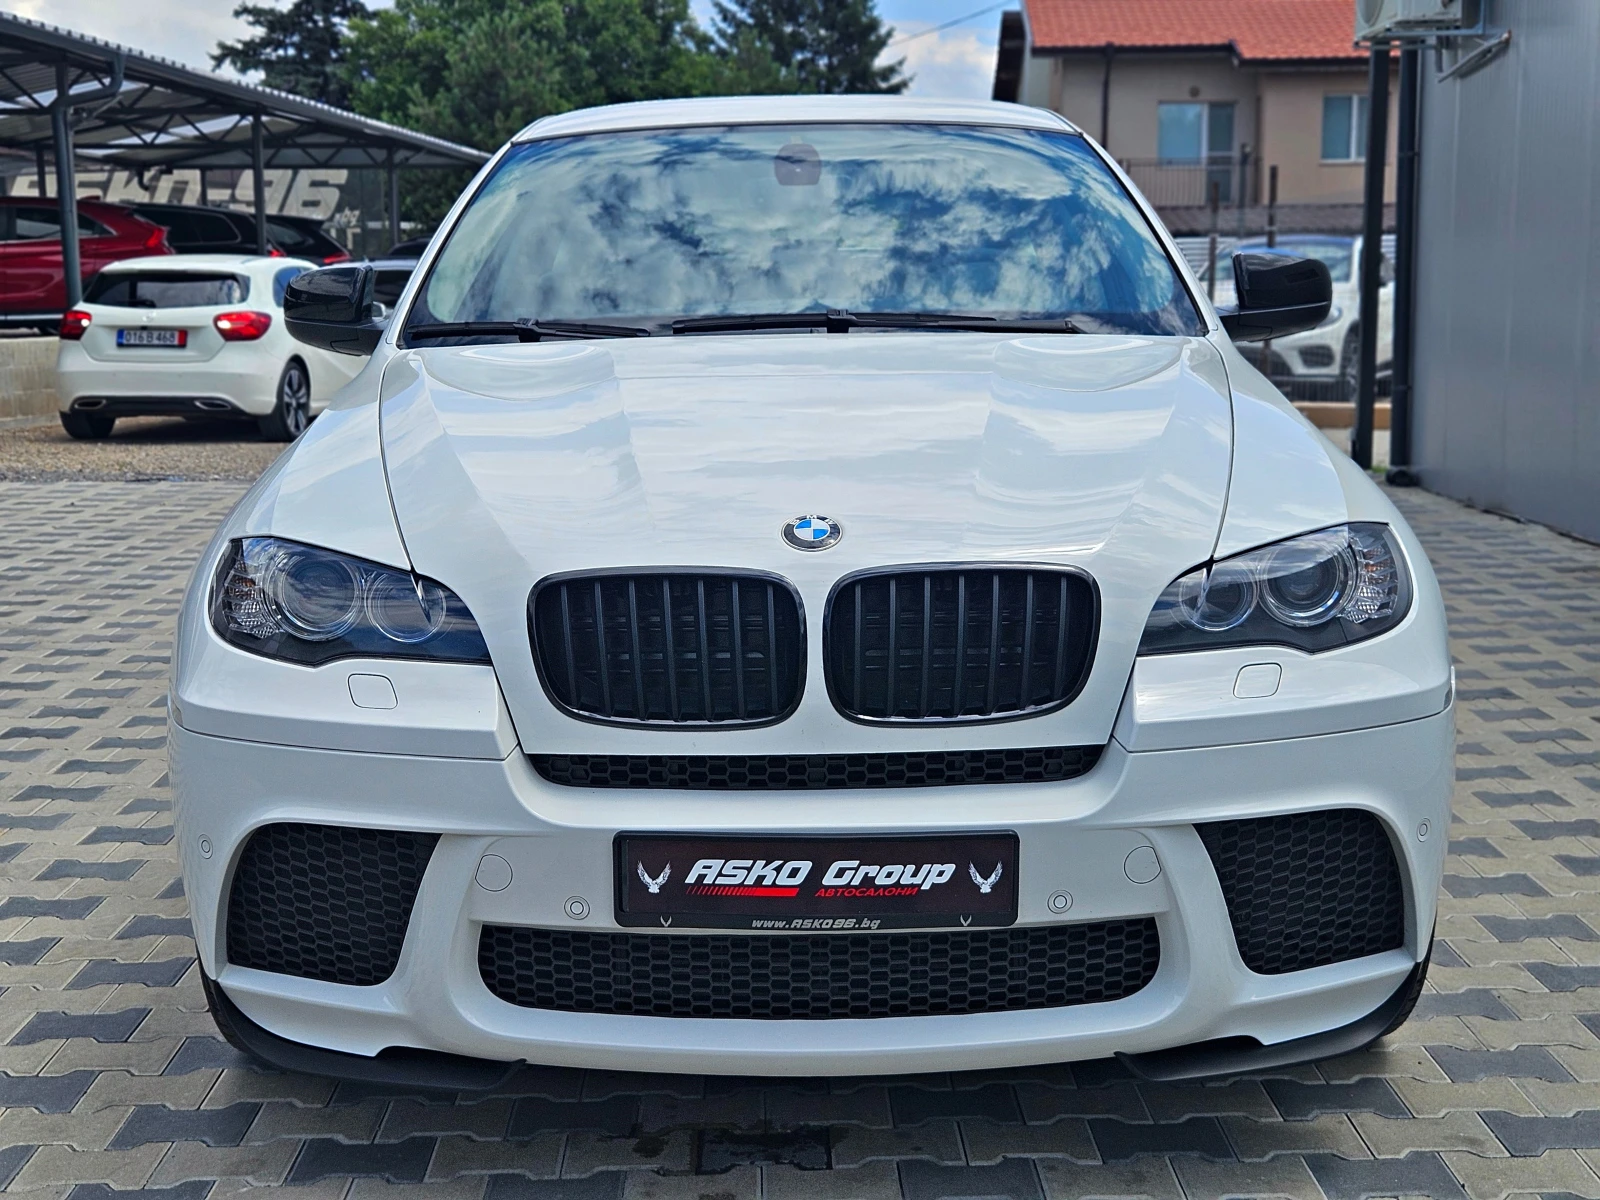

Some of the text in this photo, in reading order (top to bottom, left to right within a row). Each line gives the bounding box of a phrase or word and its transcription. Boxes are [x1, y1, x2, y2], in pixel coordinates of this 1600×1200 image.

[684, 859, 957, 890] ASKO Group
[815, 887, 919, 897] АВТОСАЛОНИ
[751, 918, 881, 929] www.ASKO96.bg
